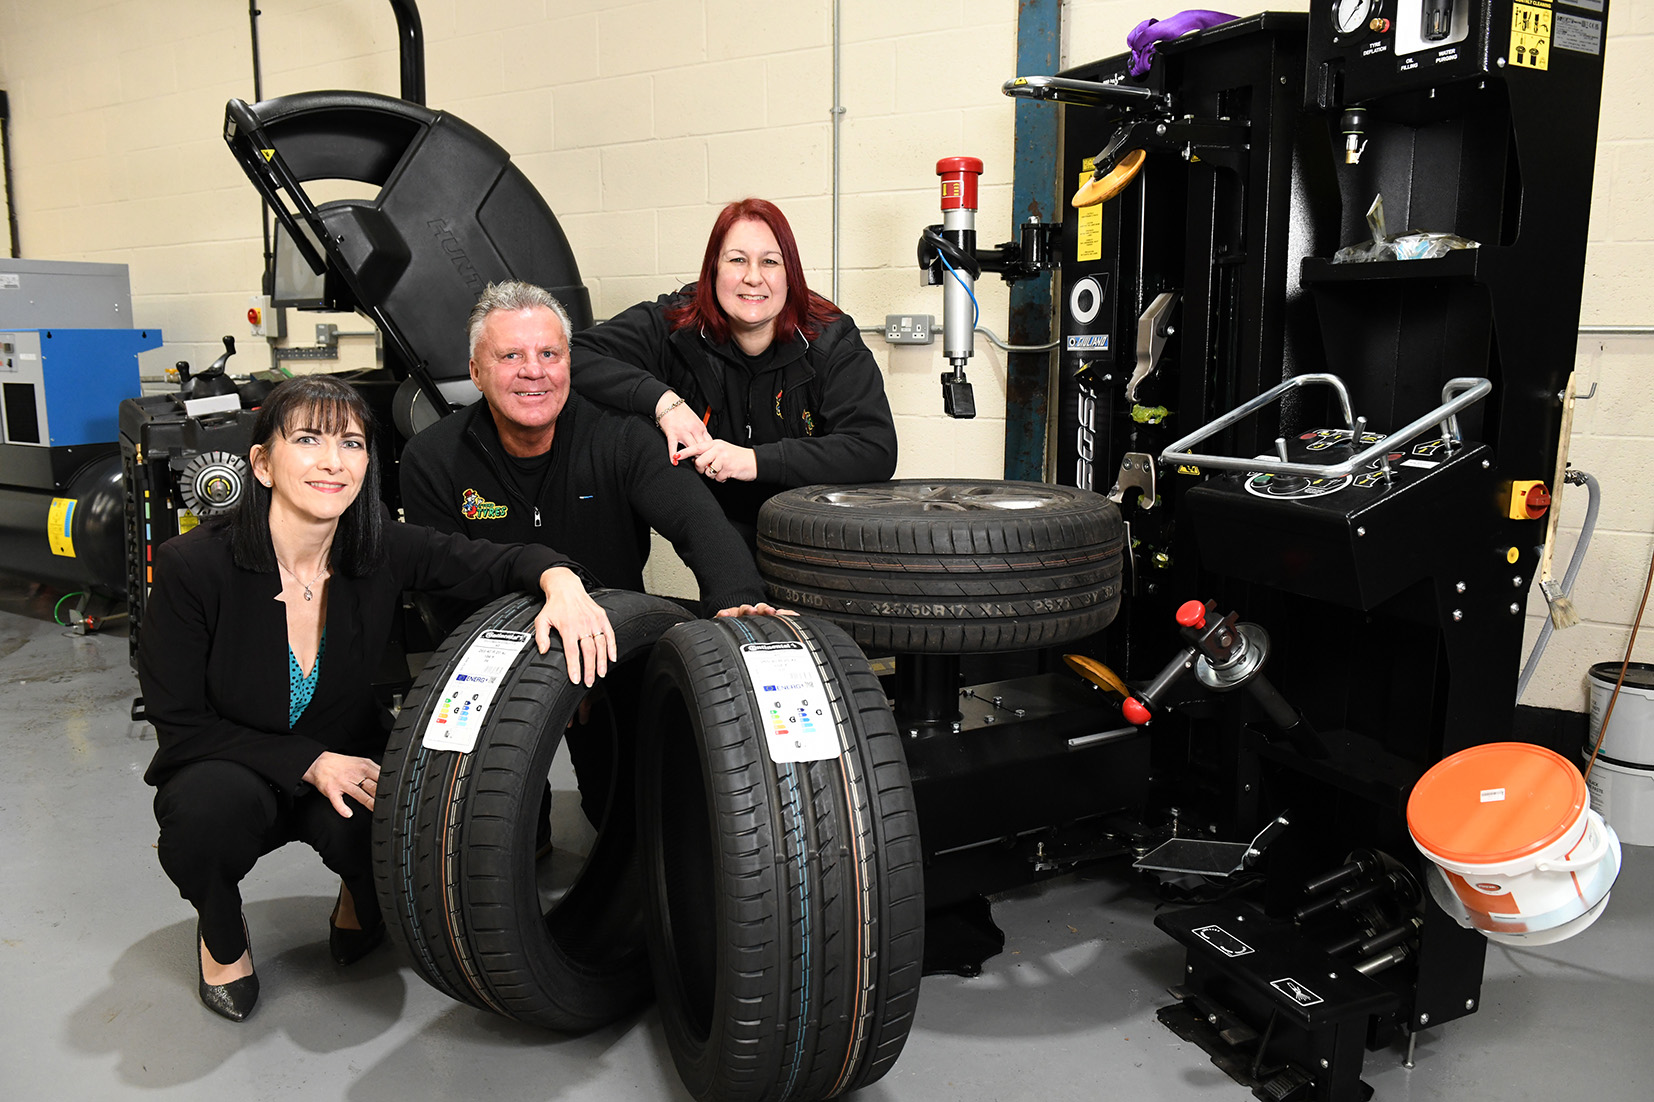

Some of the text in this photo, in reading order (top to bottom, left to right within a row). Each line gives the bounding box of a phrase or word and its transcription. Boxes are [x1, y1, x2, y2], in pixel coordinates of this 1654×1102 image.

[1438, 48, 1456, 57] WATER
[1400, 62, 1419, 71] FILLING
[427, 218, 488, 303] HUNT
[477, 507, 507, 517] TYRES
[748, 643, 791, 651] Continental
